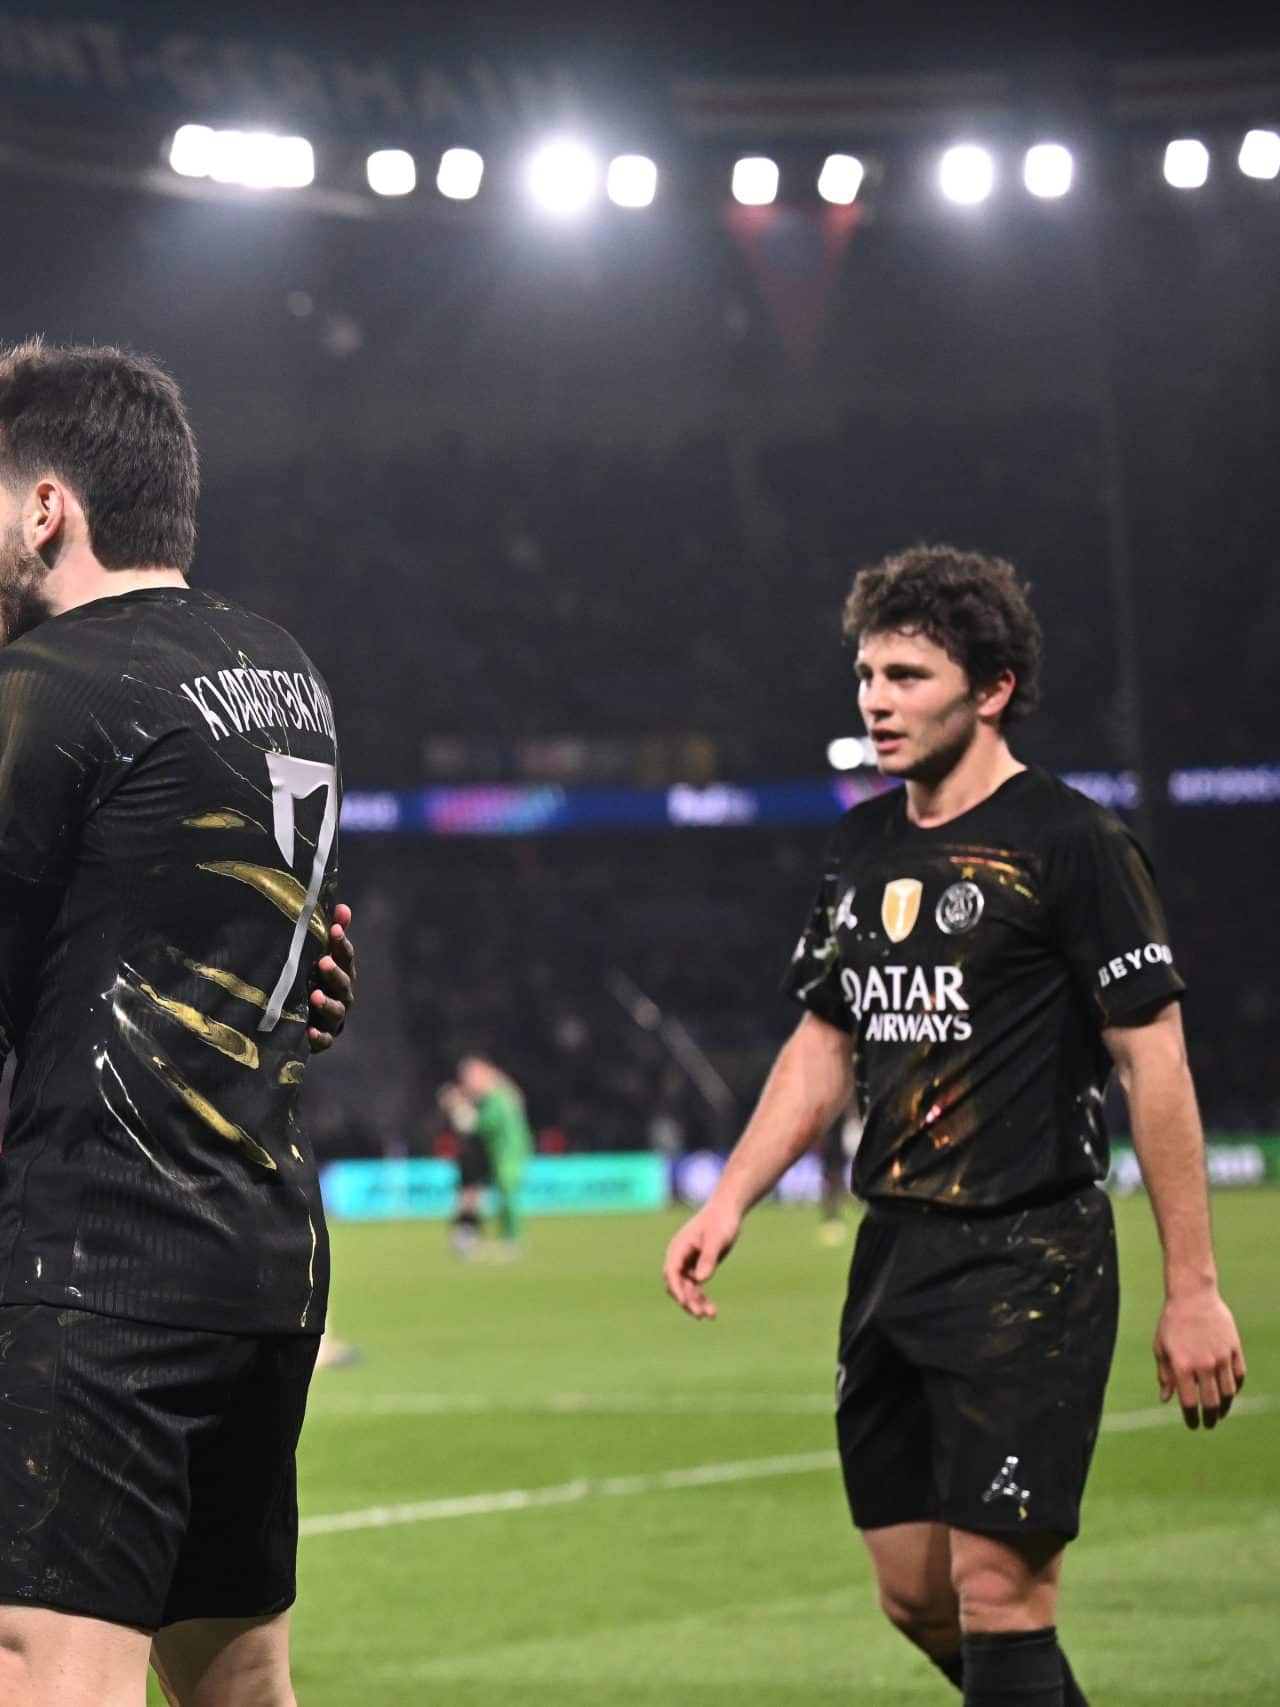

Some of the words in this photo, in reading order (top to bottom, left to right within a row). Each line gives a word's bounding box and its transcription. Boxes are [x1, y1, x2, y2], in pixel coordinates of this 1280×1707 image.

[256, 752, 336, 1032] 7
[840, 965, 970, 1021] QATAR
[865, 1012, 973, 1043] AIRWAYS
